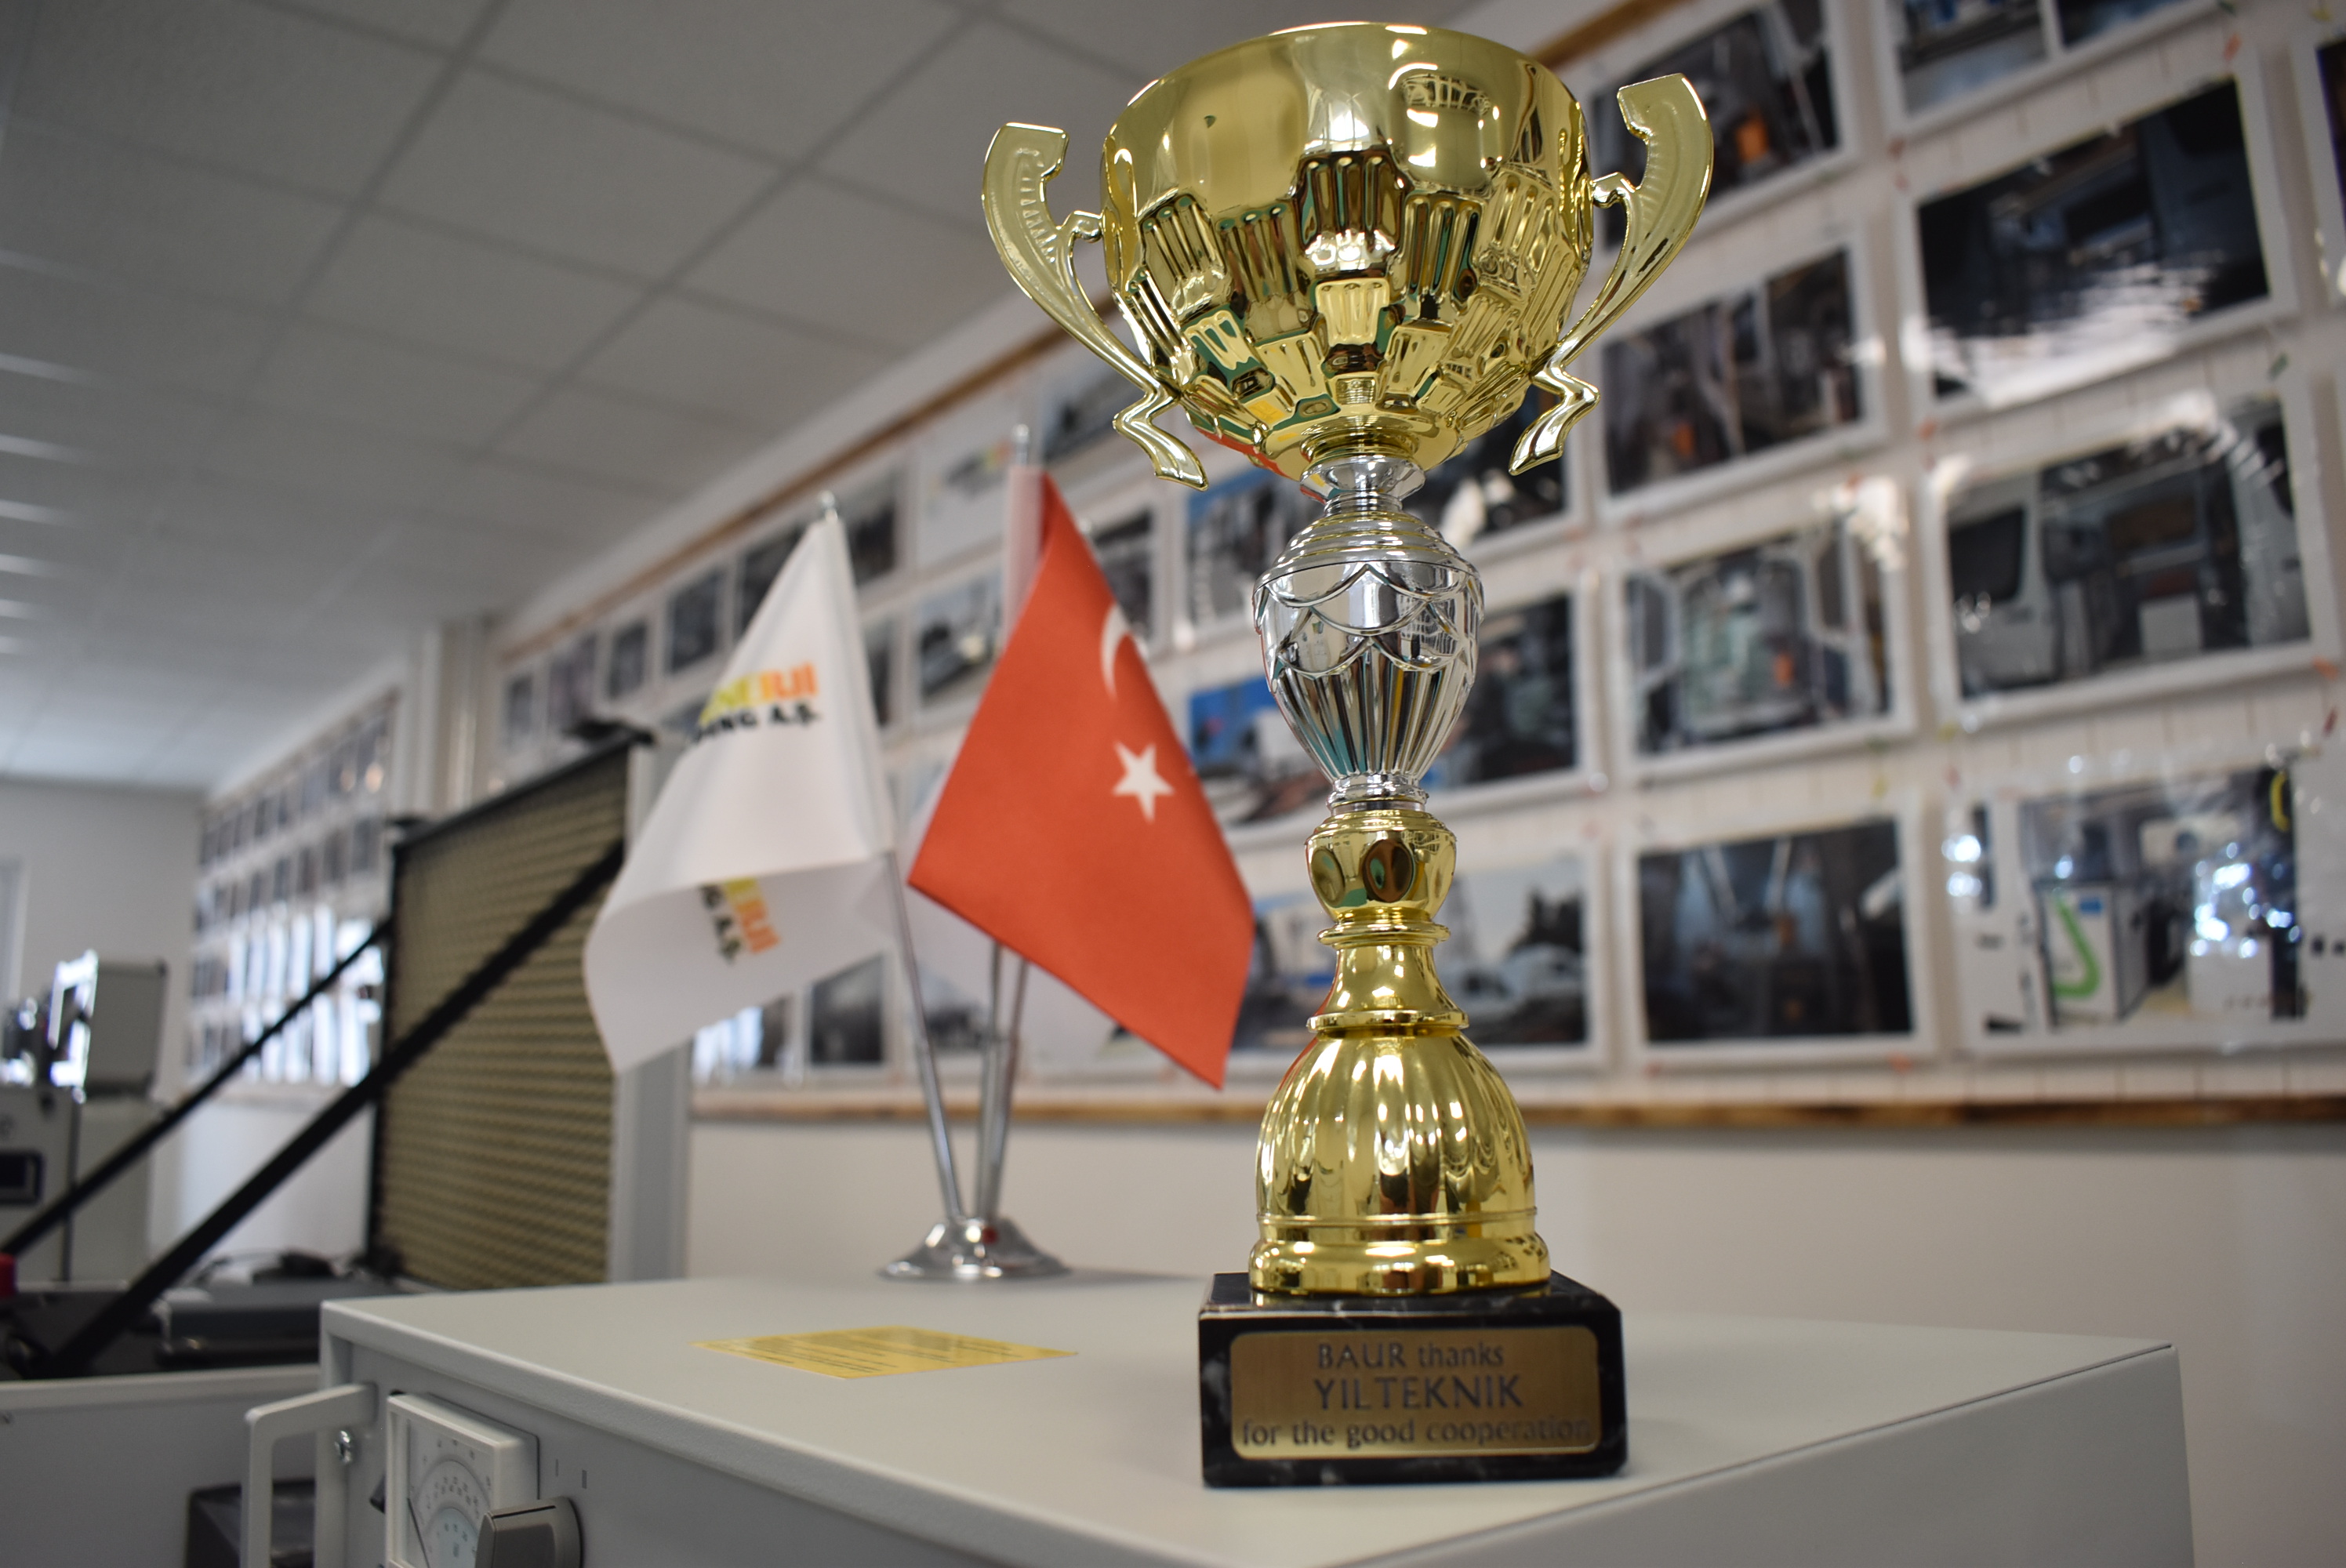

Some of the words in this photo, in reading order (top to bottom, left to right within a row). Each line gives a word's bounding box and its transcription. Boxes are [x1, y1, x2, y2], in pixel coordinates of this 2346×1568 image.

[1318, 1342, 1407, 1369] BAUR
[1418, 1339, 1504, 1368] thanks
[1313, 1374, 1524, 1410] YILTEKNIK
[1243, 1419, 1280, 1446] for
[1292, 1418, 1335, 1446] the
[1346, 1417, 1414, 1450] good
[1425, 1414, 1591, 1446] cooperation
